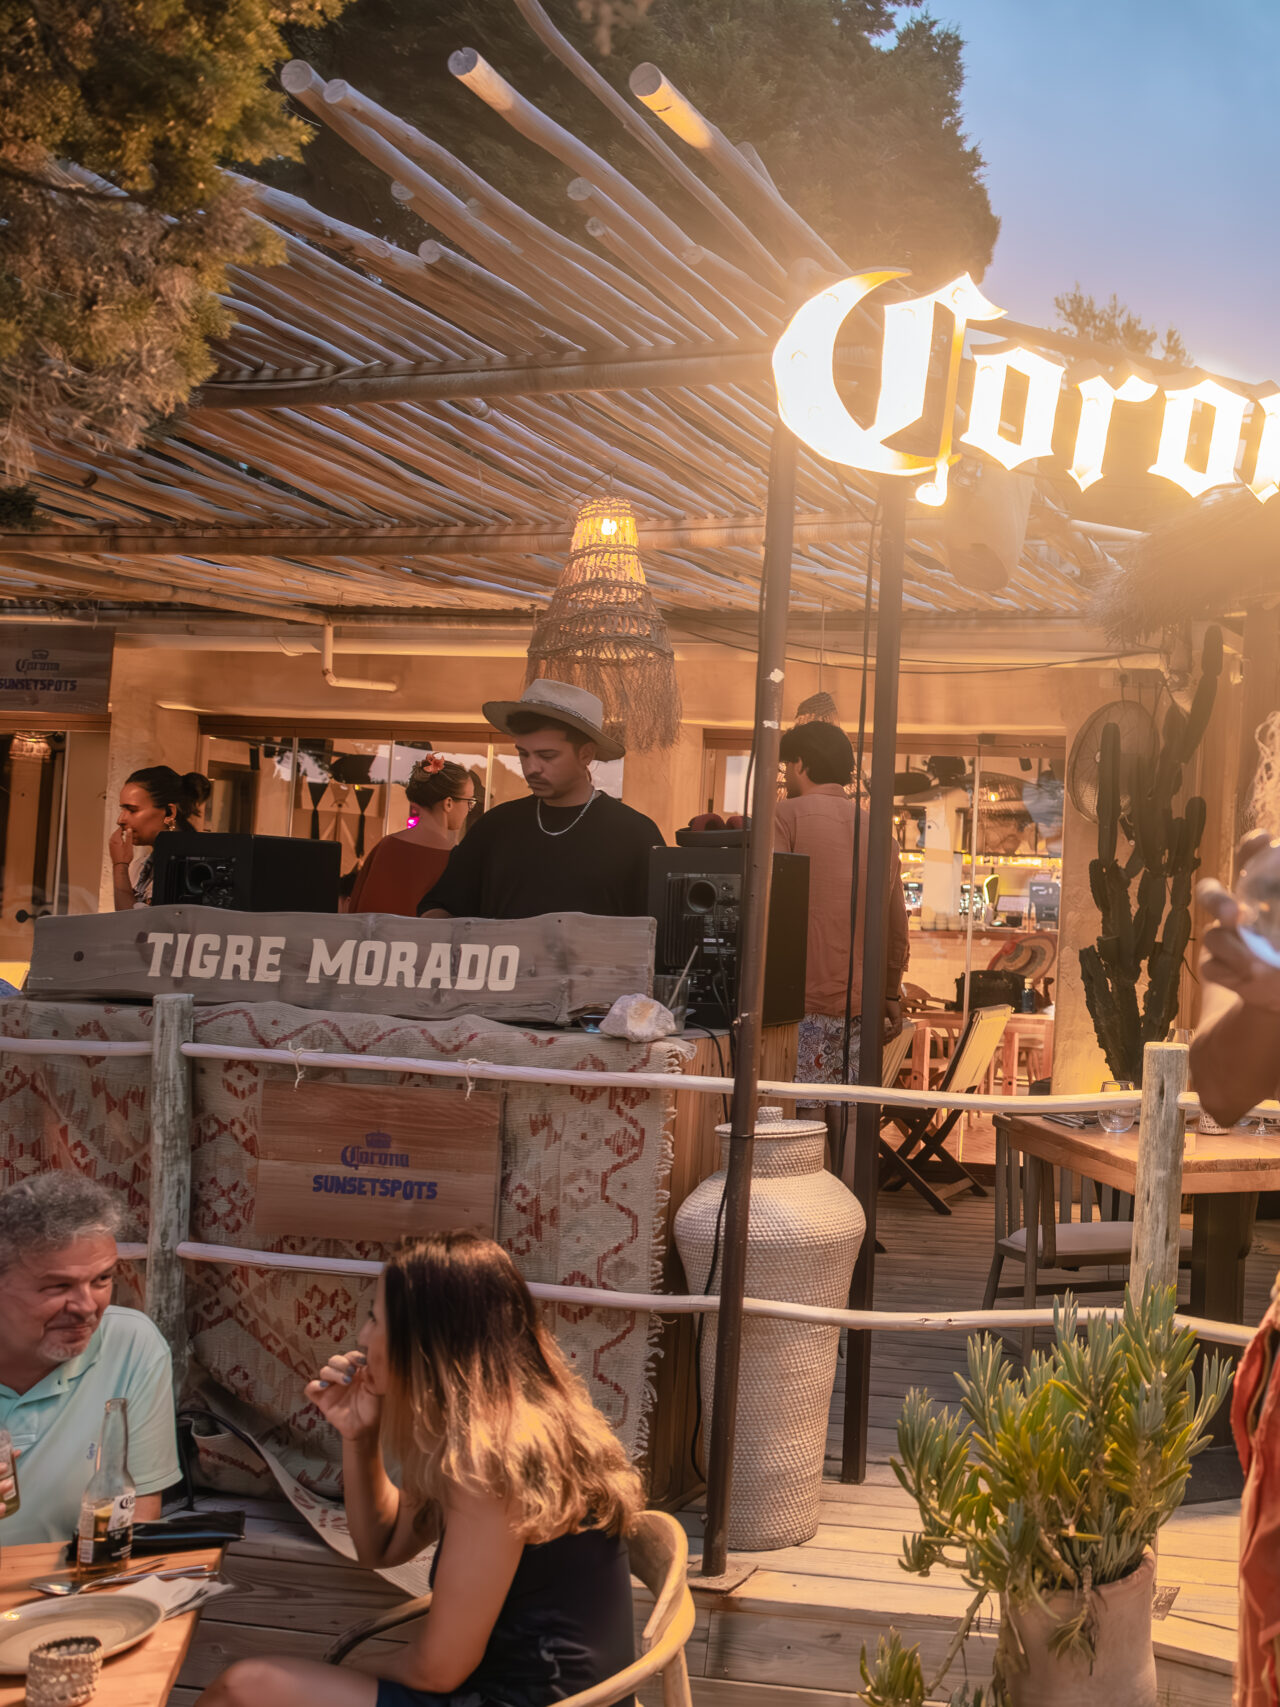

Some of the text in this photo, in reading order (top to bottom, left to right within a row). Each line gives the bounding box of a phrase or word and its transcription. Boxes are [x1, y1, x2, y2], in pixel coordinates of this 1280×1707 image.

[146, 931, 521, 992] TIGRE MORADO
[340, 1144, 410, 1171] Corona
[312, 1174, 439, 1201] SUNSETSPOTS
